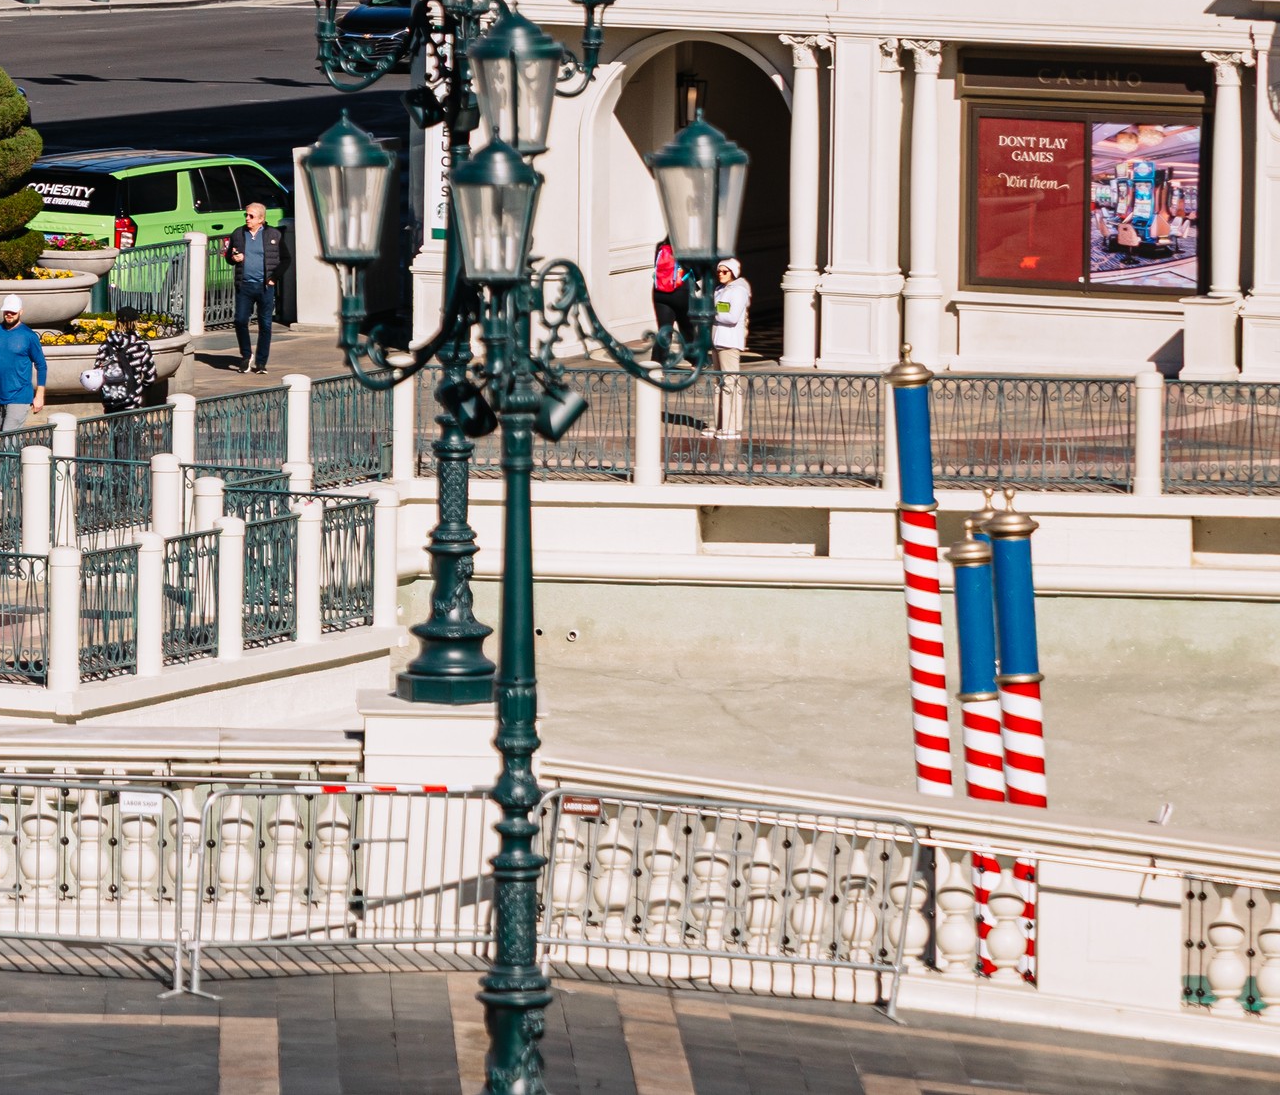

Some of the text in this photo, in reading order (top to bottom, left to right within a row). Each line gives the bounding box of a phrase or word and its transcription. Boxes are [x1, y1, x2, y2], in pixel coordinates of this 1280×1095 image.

[1038, 68, 1142, 88] CASINO
[998, 135, 1068, 150] DON'T PLAY
[1011, 151, 1054, 163] GAMES
[998, 172, 1070, 190] Win them
